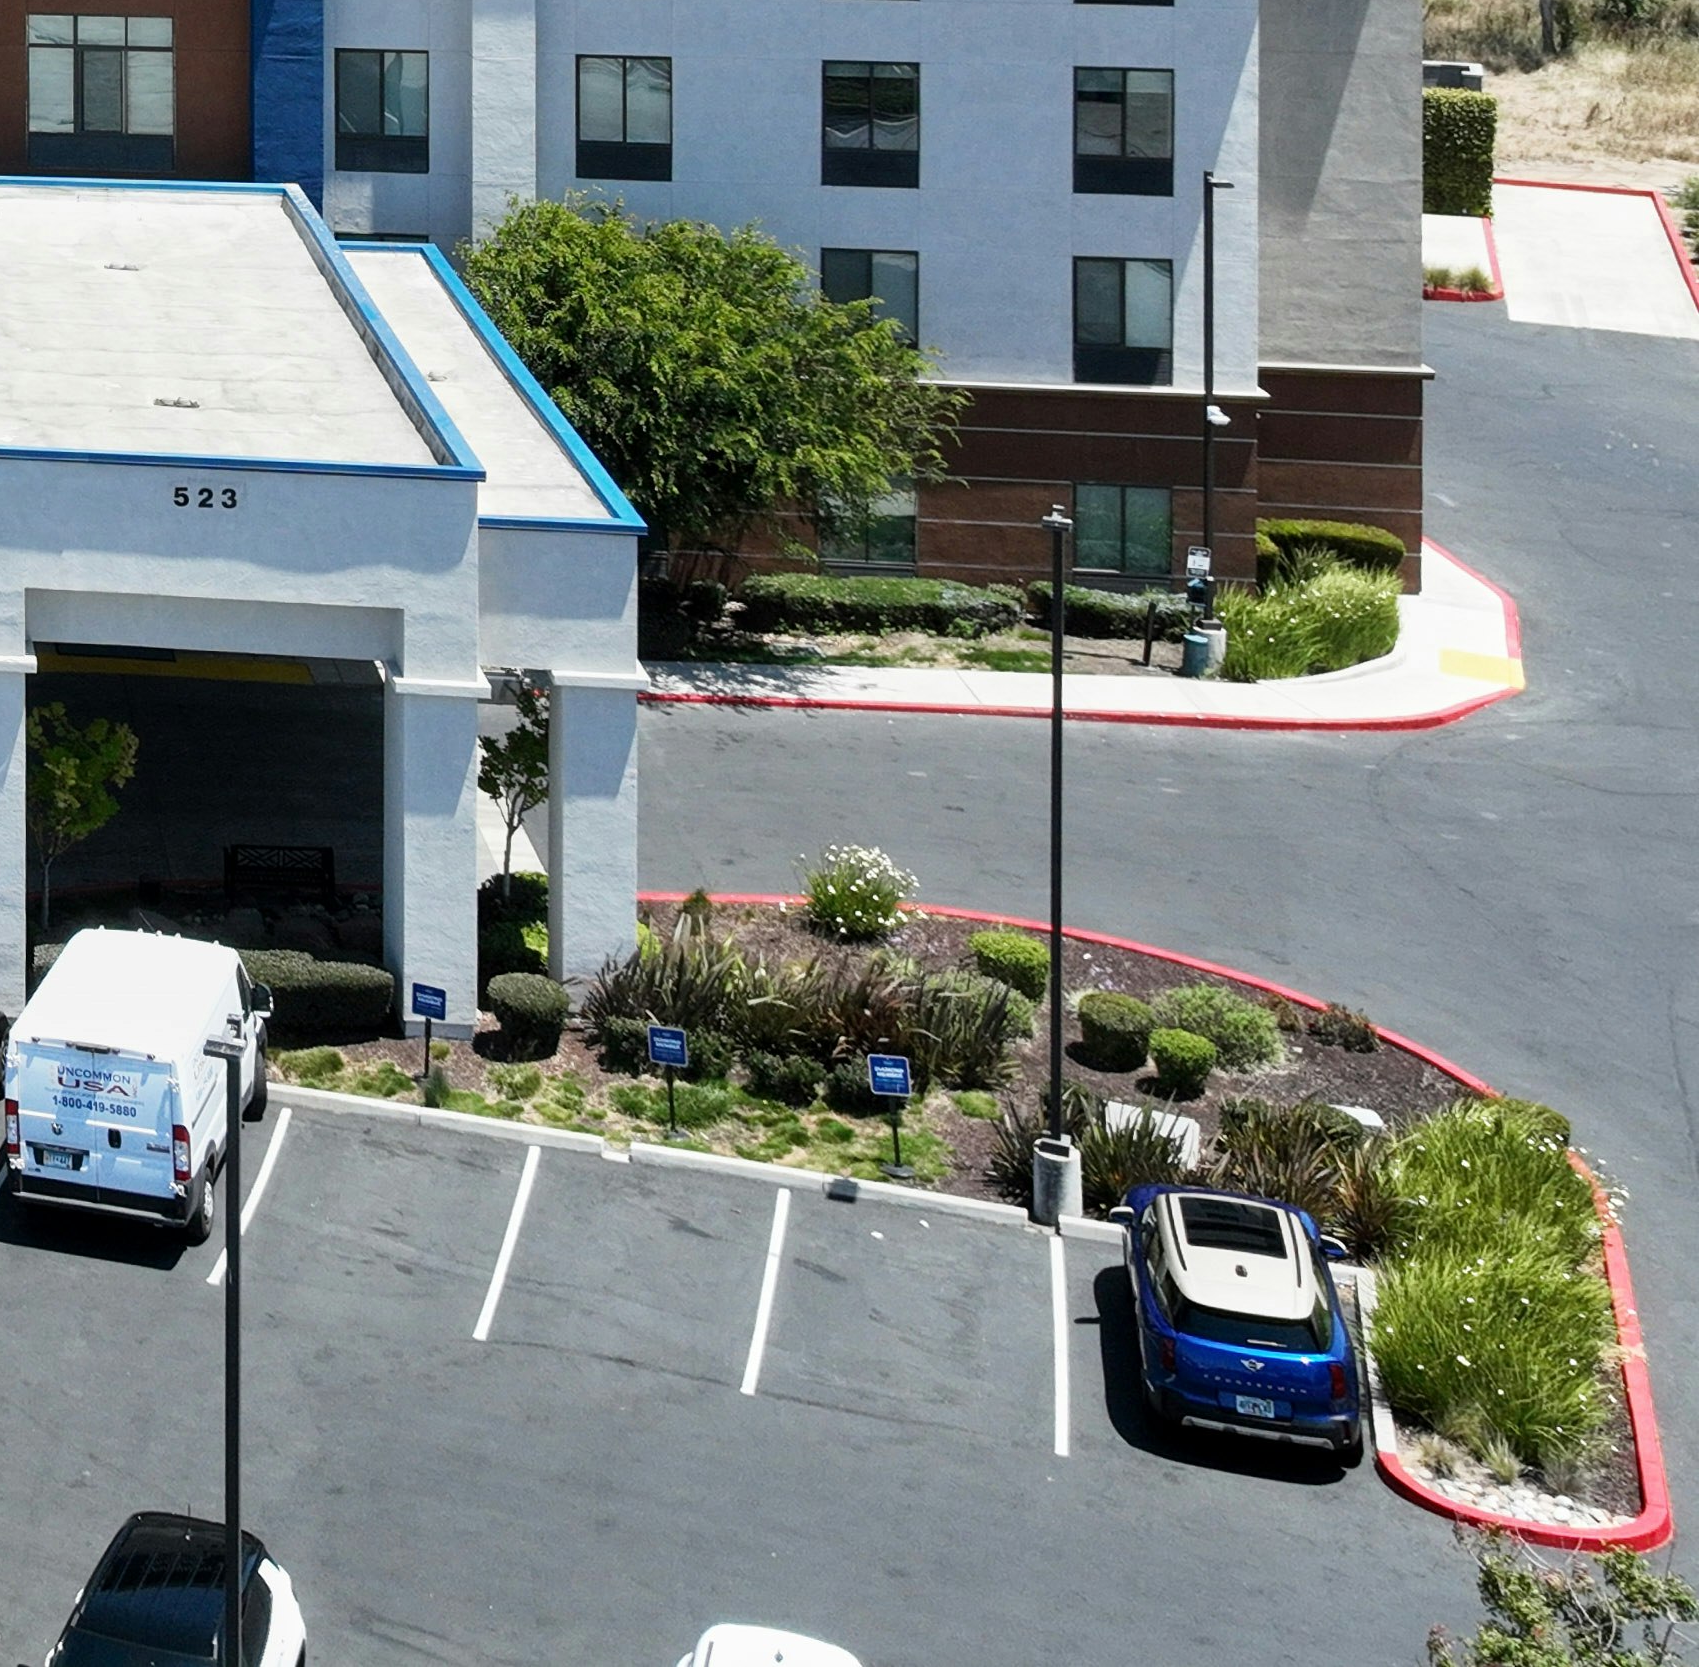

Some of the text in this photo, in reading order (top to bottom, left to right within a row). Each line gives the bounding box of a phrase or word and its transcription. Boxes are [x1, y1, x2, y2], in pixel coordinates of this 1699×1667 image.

[173, 486, 238, 509] 523
[57, 1065, 132, 1085] UNCOMMON
[57, 1076, 131, 1097] USA
